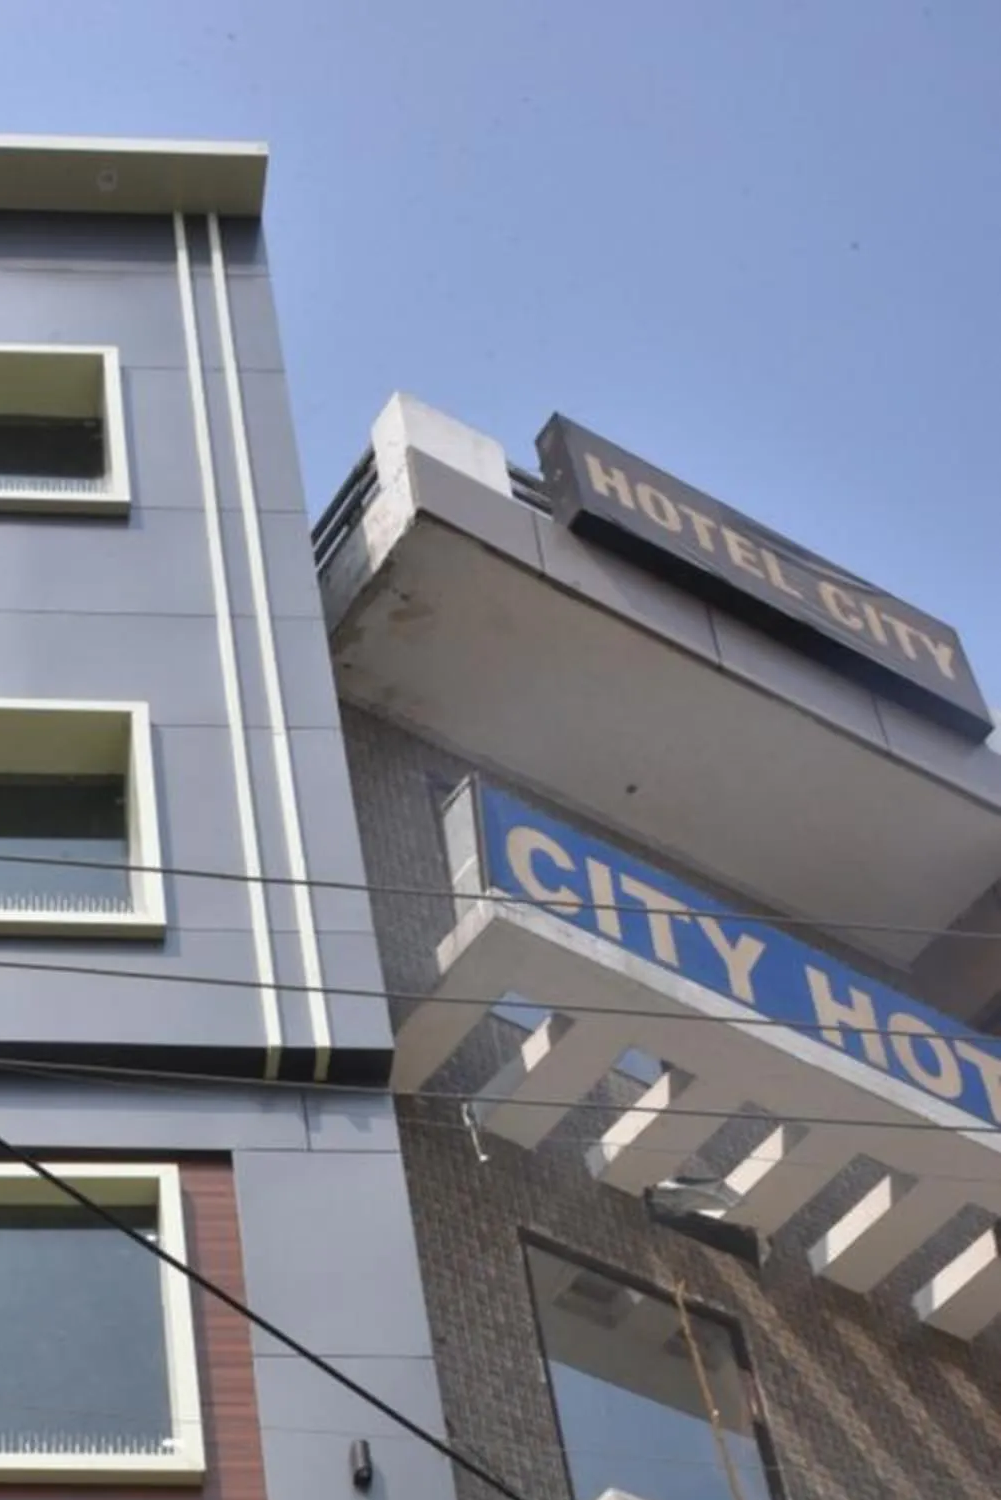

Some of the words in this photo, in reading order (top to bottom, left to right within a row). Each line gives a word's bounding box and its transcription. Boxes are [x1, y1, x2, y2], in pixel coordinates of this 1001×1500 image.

[583, 452, 802, 599] HOTEL
[819, 582, 956, 681] CITY
[506, 825, 767, 1005] CITY
